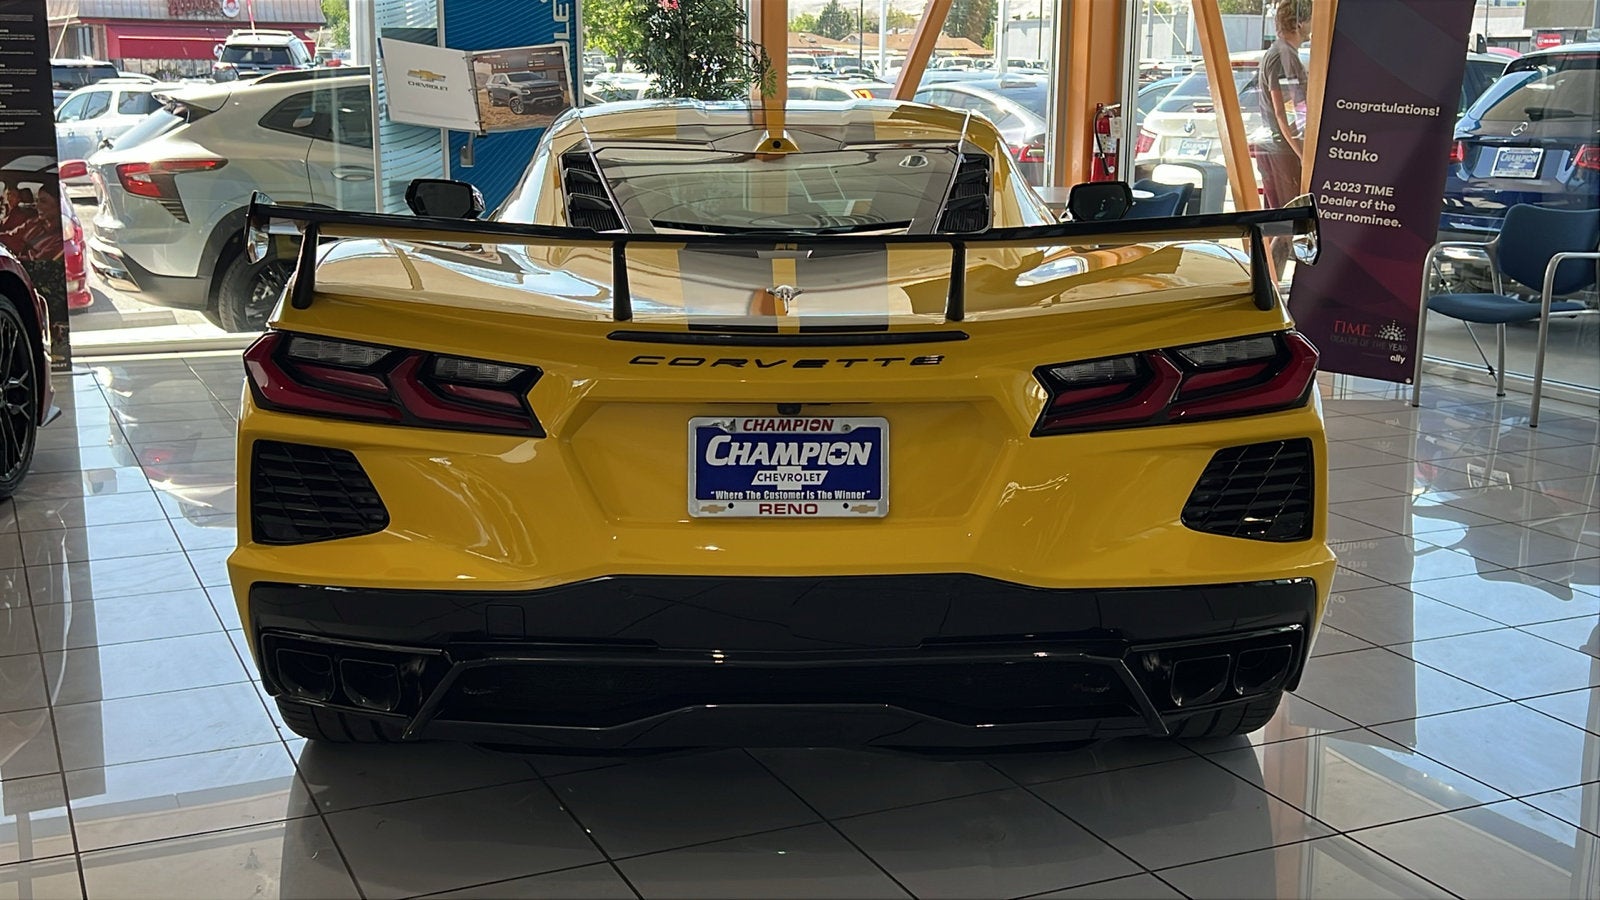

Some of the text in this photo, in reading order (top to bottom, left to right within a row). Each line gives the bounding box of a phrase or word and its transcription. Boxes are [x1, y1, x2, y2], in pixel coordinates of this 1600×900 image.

[1336, 99, 1440, 116] Congratulations!
[1331, 129, 1367, 144] John
[1328, 146, 1379, 162] Stanko
[1322, 180, 1394, 197] A 2023 TIME
[1320, 194, 1396, 212] Dealer of the
[1318, 208, 1402, 228] Year nominee.
[1334, 320, 1371, 337] TIME
[628, 355, 945, 369] CORVETTE
[1390, 354, 1406, 365] ally
[742, 418, 835, 432] CHAMPION
[705, 435, 872, 466] CHAMPION
[757, 472, 822, 483] CHEVROLET
[745, 490, 760, 500] The
[763, 490, 805, 500] Customer
[806, 490, 815, 500] Is
[817, 490, 833, 500] The
[759, 503, 819, 514] RENO
